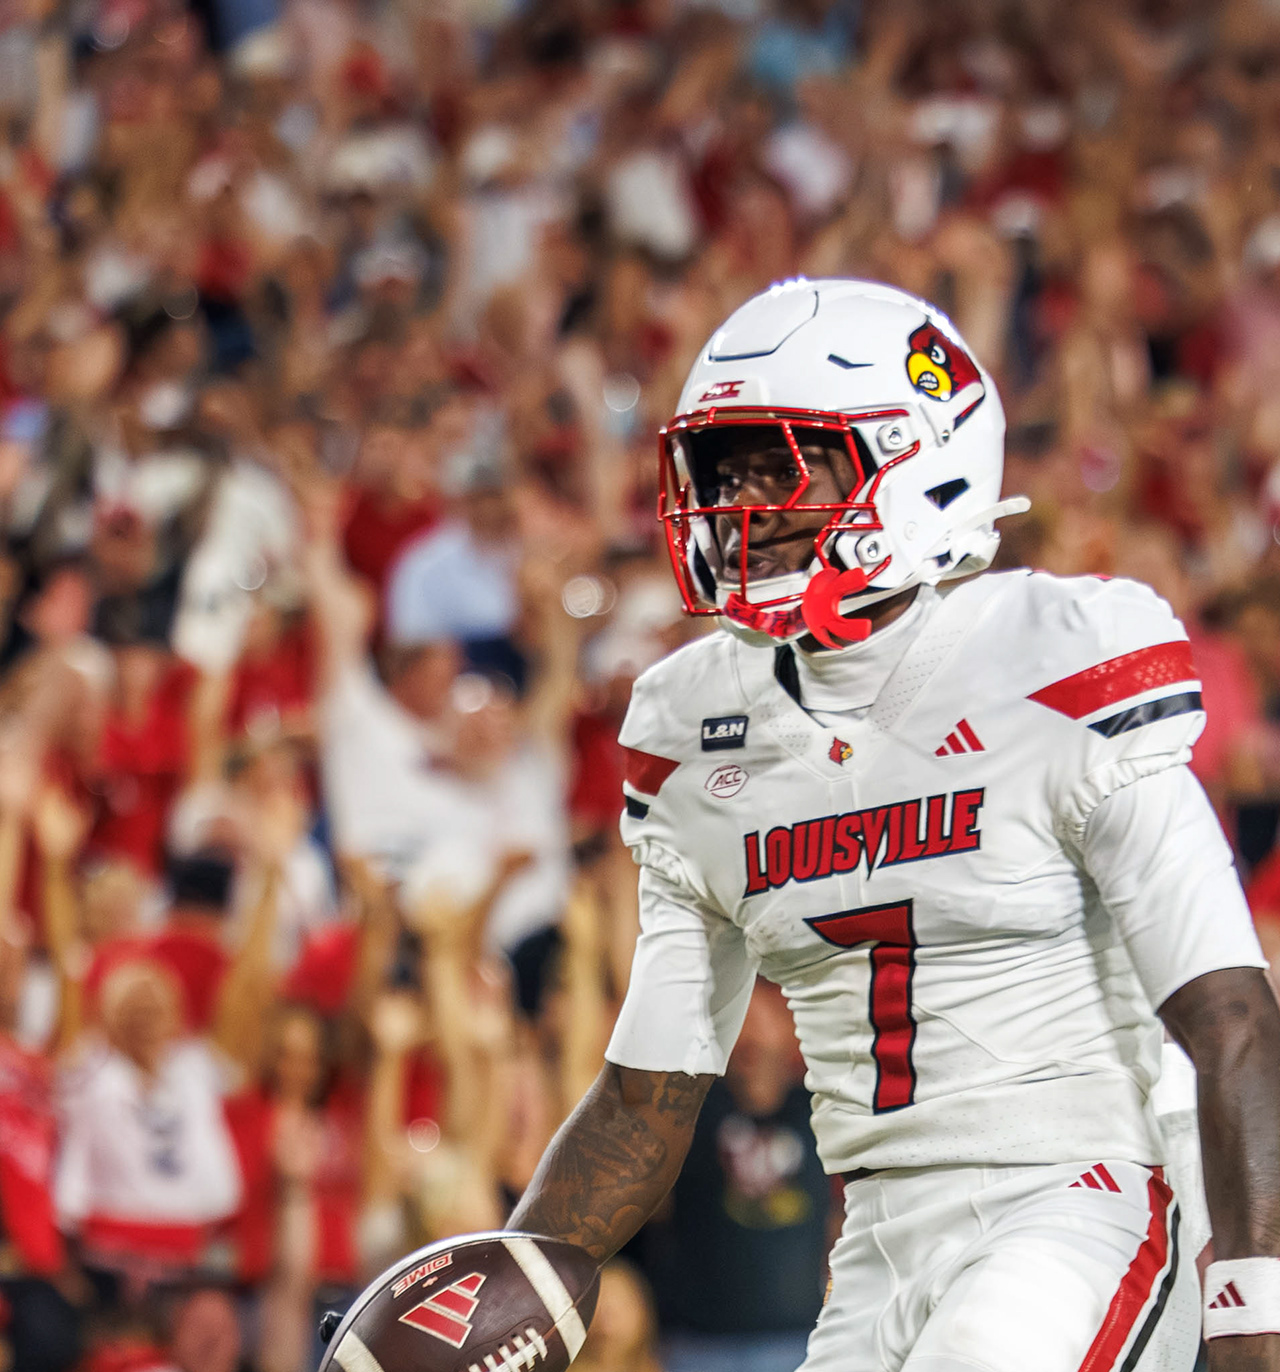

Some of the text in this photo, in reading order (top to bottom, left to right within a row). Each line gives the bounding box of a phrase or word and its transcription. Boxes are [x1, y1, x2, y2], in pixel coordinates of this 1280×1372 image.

[703, 722, 745, 740] L&N
[712, 769, 742, 788] ACC
[743, 787, 986, 898] LOUISVILLE
[803, 899, 918, 1115] 7
[390, 1252, 454, 1299] DIME
